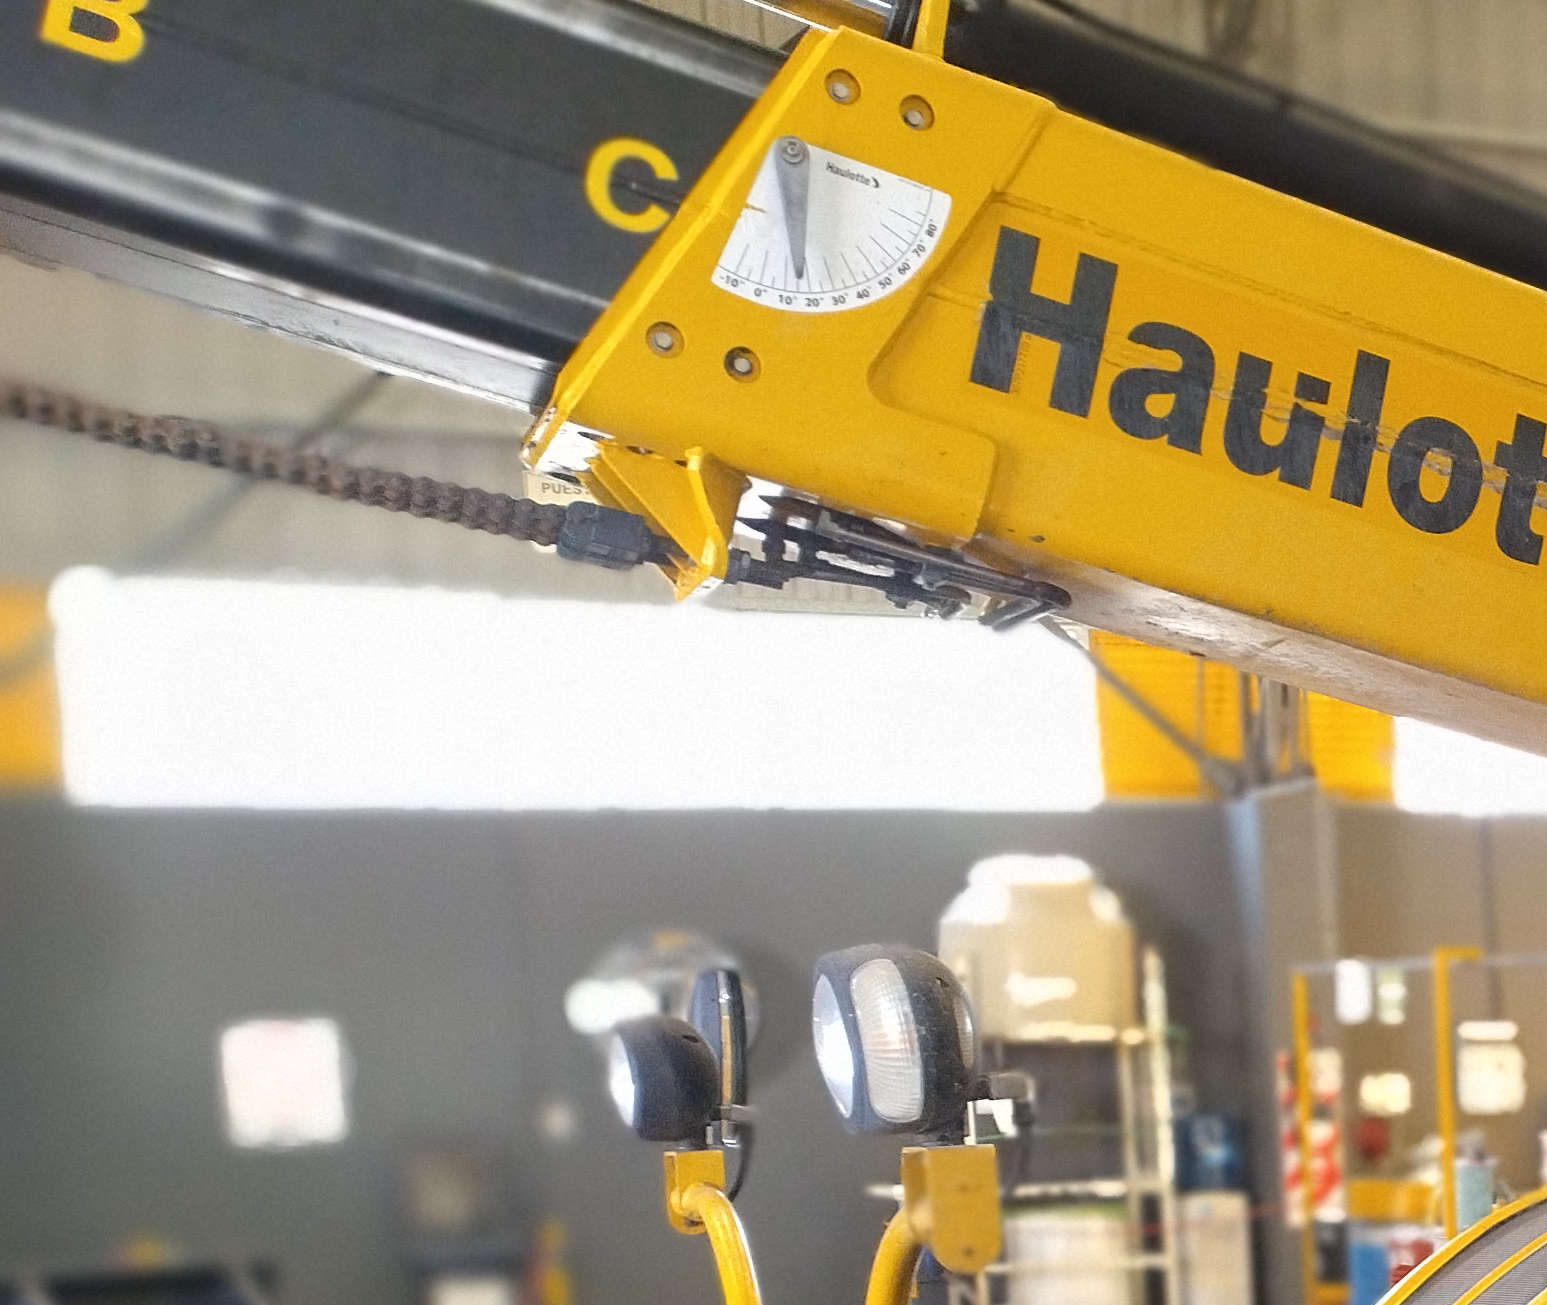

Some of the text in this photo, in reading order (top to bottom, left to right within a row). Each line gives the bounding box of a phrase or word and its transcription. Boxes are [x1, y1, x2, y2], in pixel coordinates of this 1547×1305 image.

[39, 0, 146, 63] B
[586, 138, 678, 233] C
[826, 161, 871, 186] Haulotte
[542, 482, 591, 495] PUES
